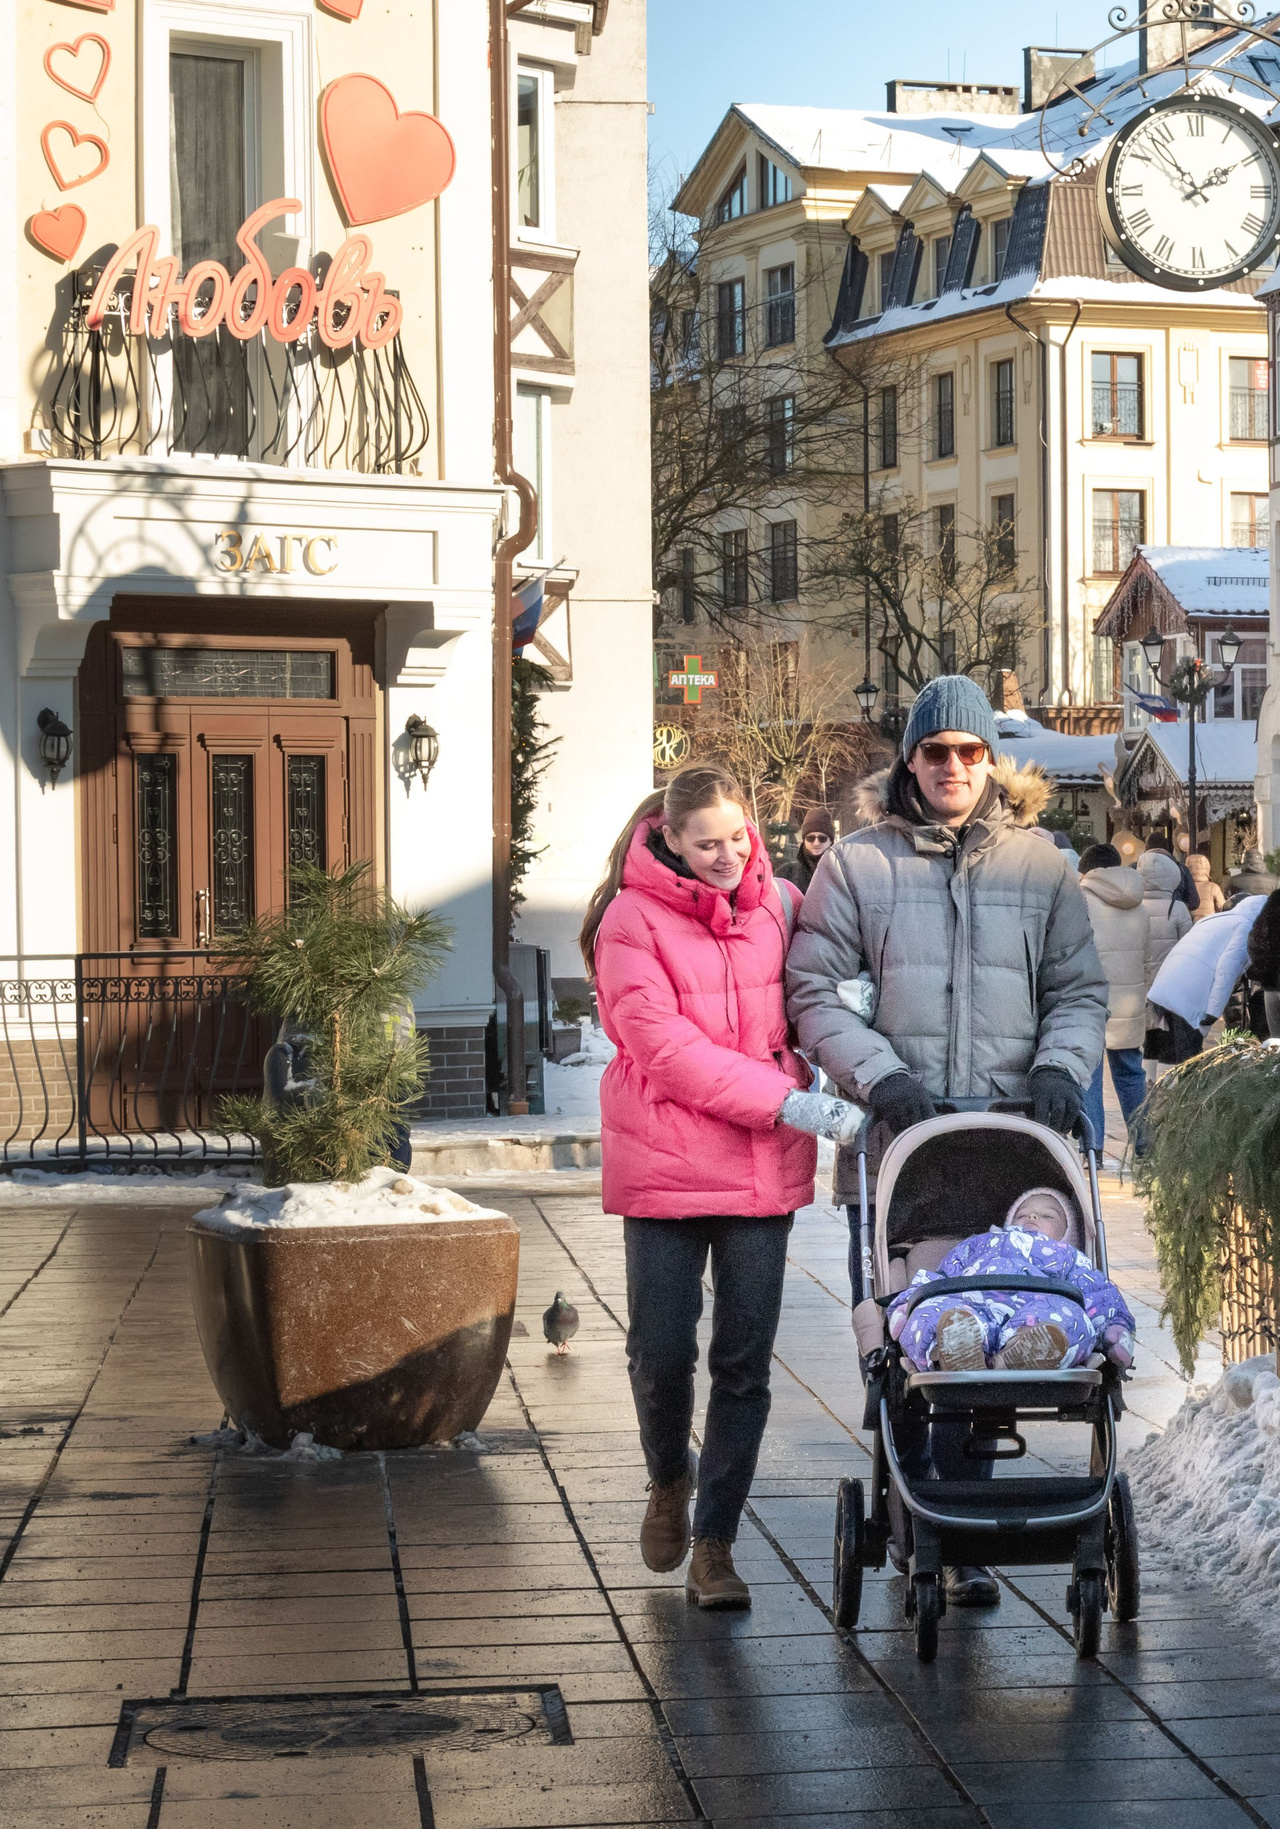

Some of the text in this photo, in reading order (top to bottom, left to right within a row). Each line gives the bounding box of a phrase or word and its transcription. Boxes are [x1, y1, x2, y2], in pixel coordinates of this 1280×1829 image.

[87, 198, 403, 350] Любовь
[220, 530, 338, 575] ЗАГС
[671, 674, 716, 686] АПТЕКА
